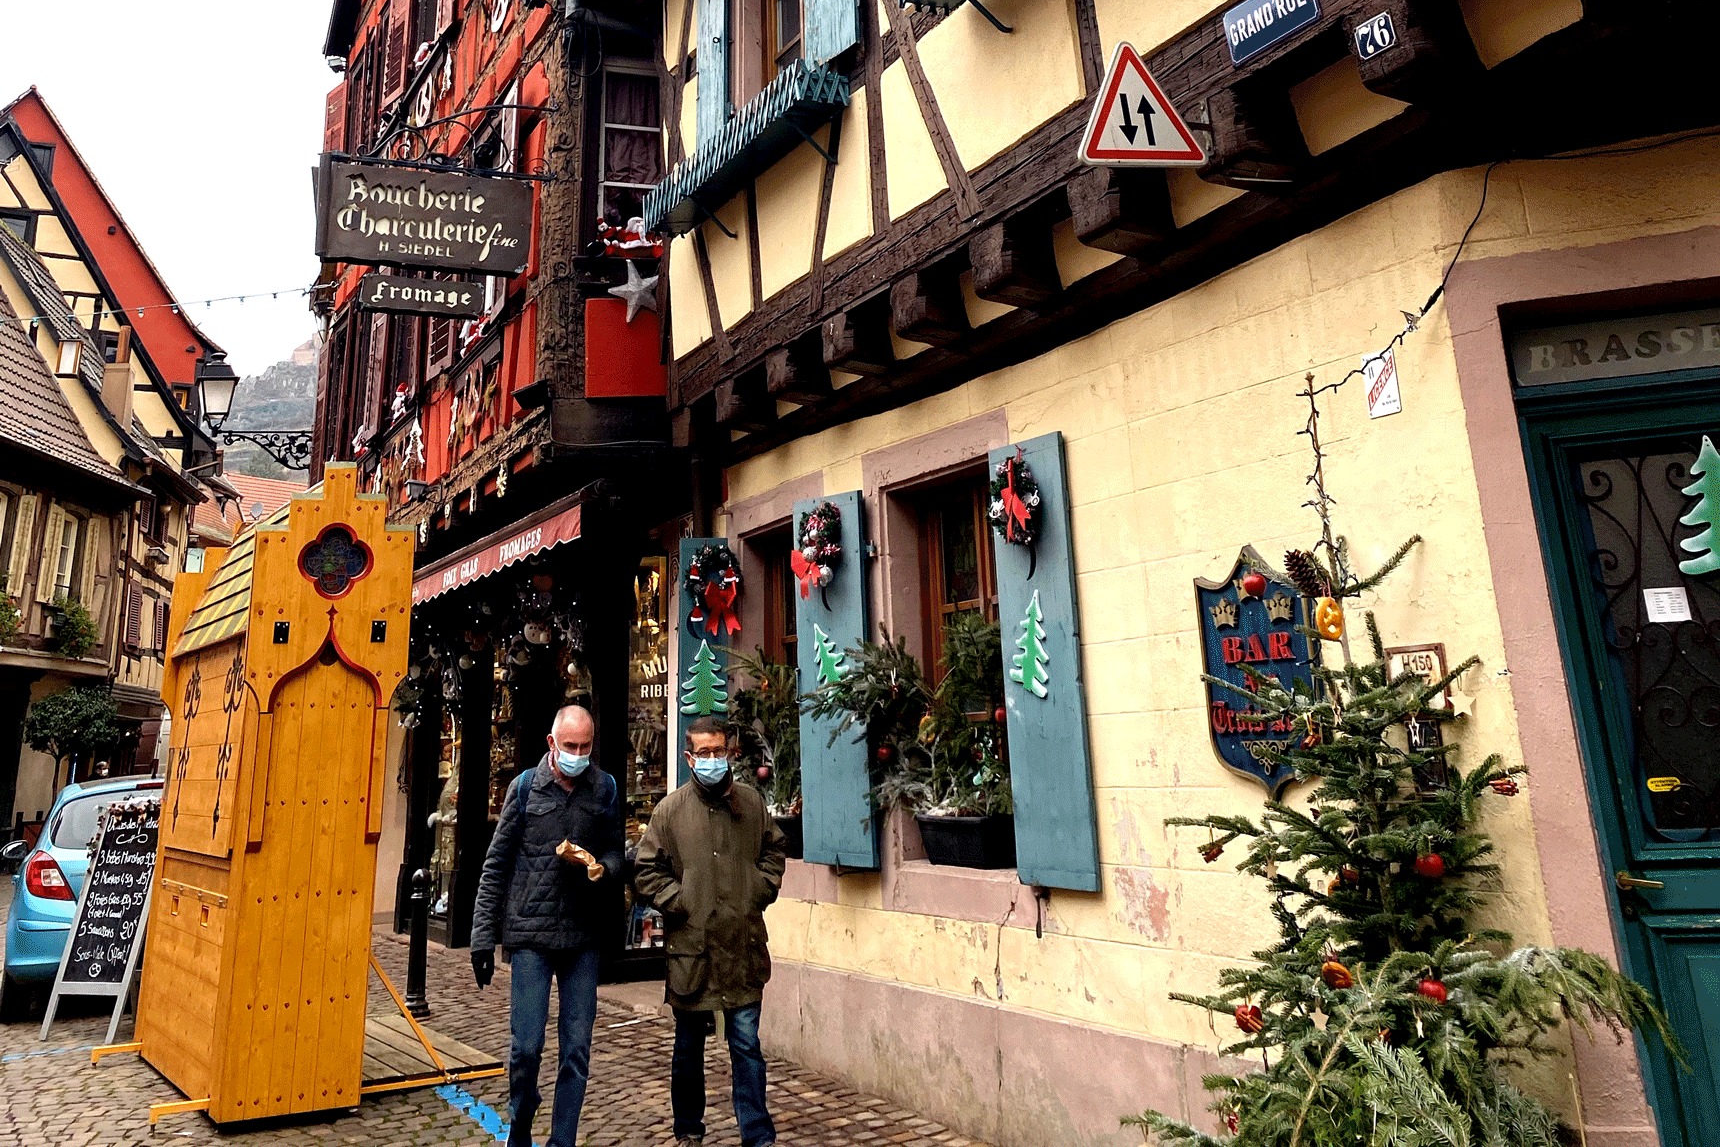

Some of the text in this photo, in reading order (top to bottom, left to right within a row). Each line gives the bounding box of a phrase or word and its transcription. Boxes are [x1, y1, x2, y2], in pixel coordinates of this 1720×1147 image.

[1357, 16, 1391, 55] 76
[345, 173, 486, 214] Boucherie
[336, 203, 519, 262] Charcuterie fine
[378, 240, 454, 258] H. SIEDEL
[370, 280, 473, 309] Fromage
[460, 557, 480, 580] GRAS
[498, 527, 543, 563] FROMAGES
[1221, 631, 1296, 664] BAR
[78, 920, 87, 937] 5
